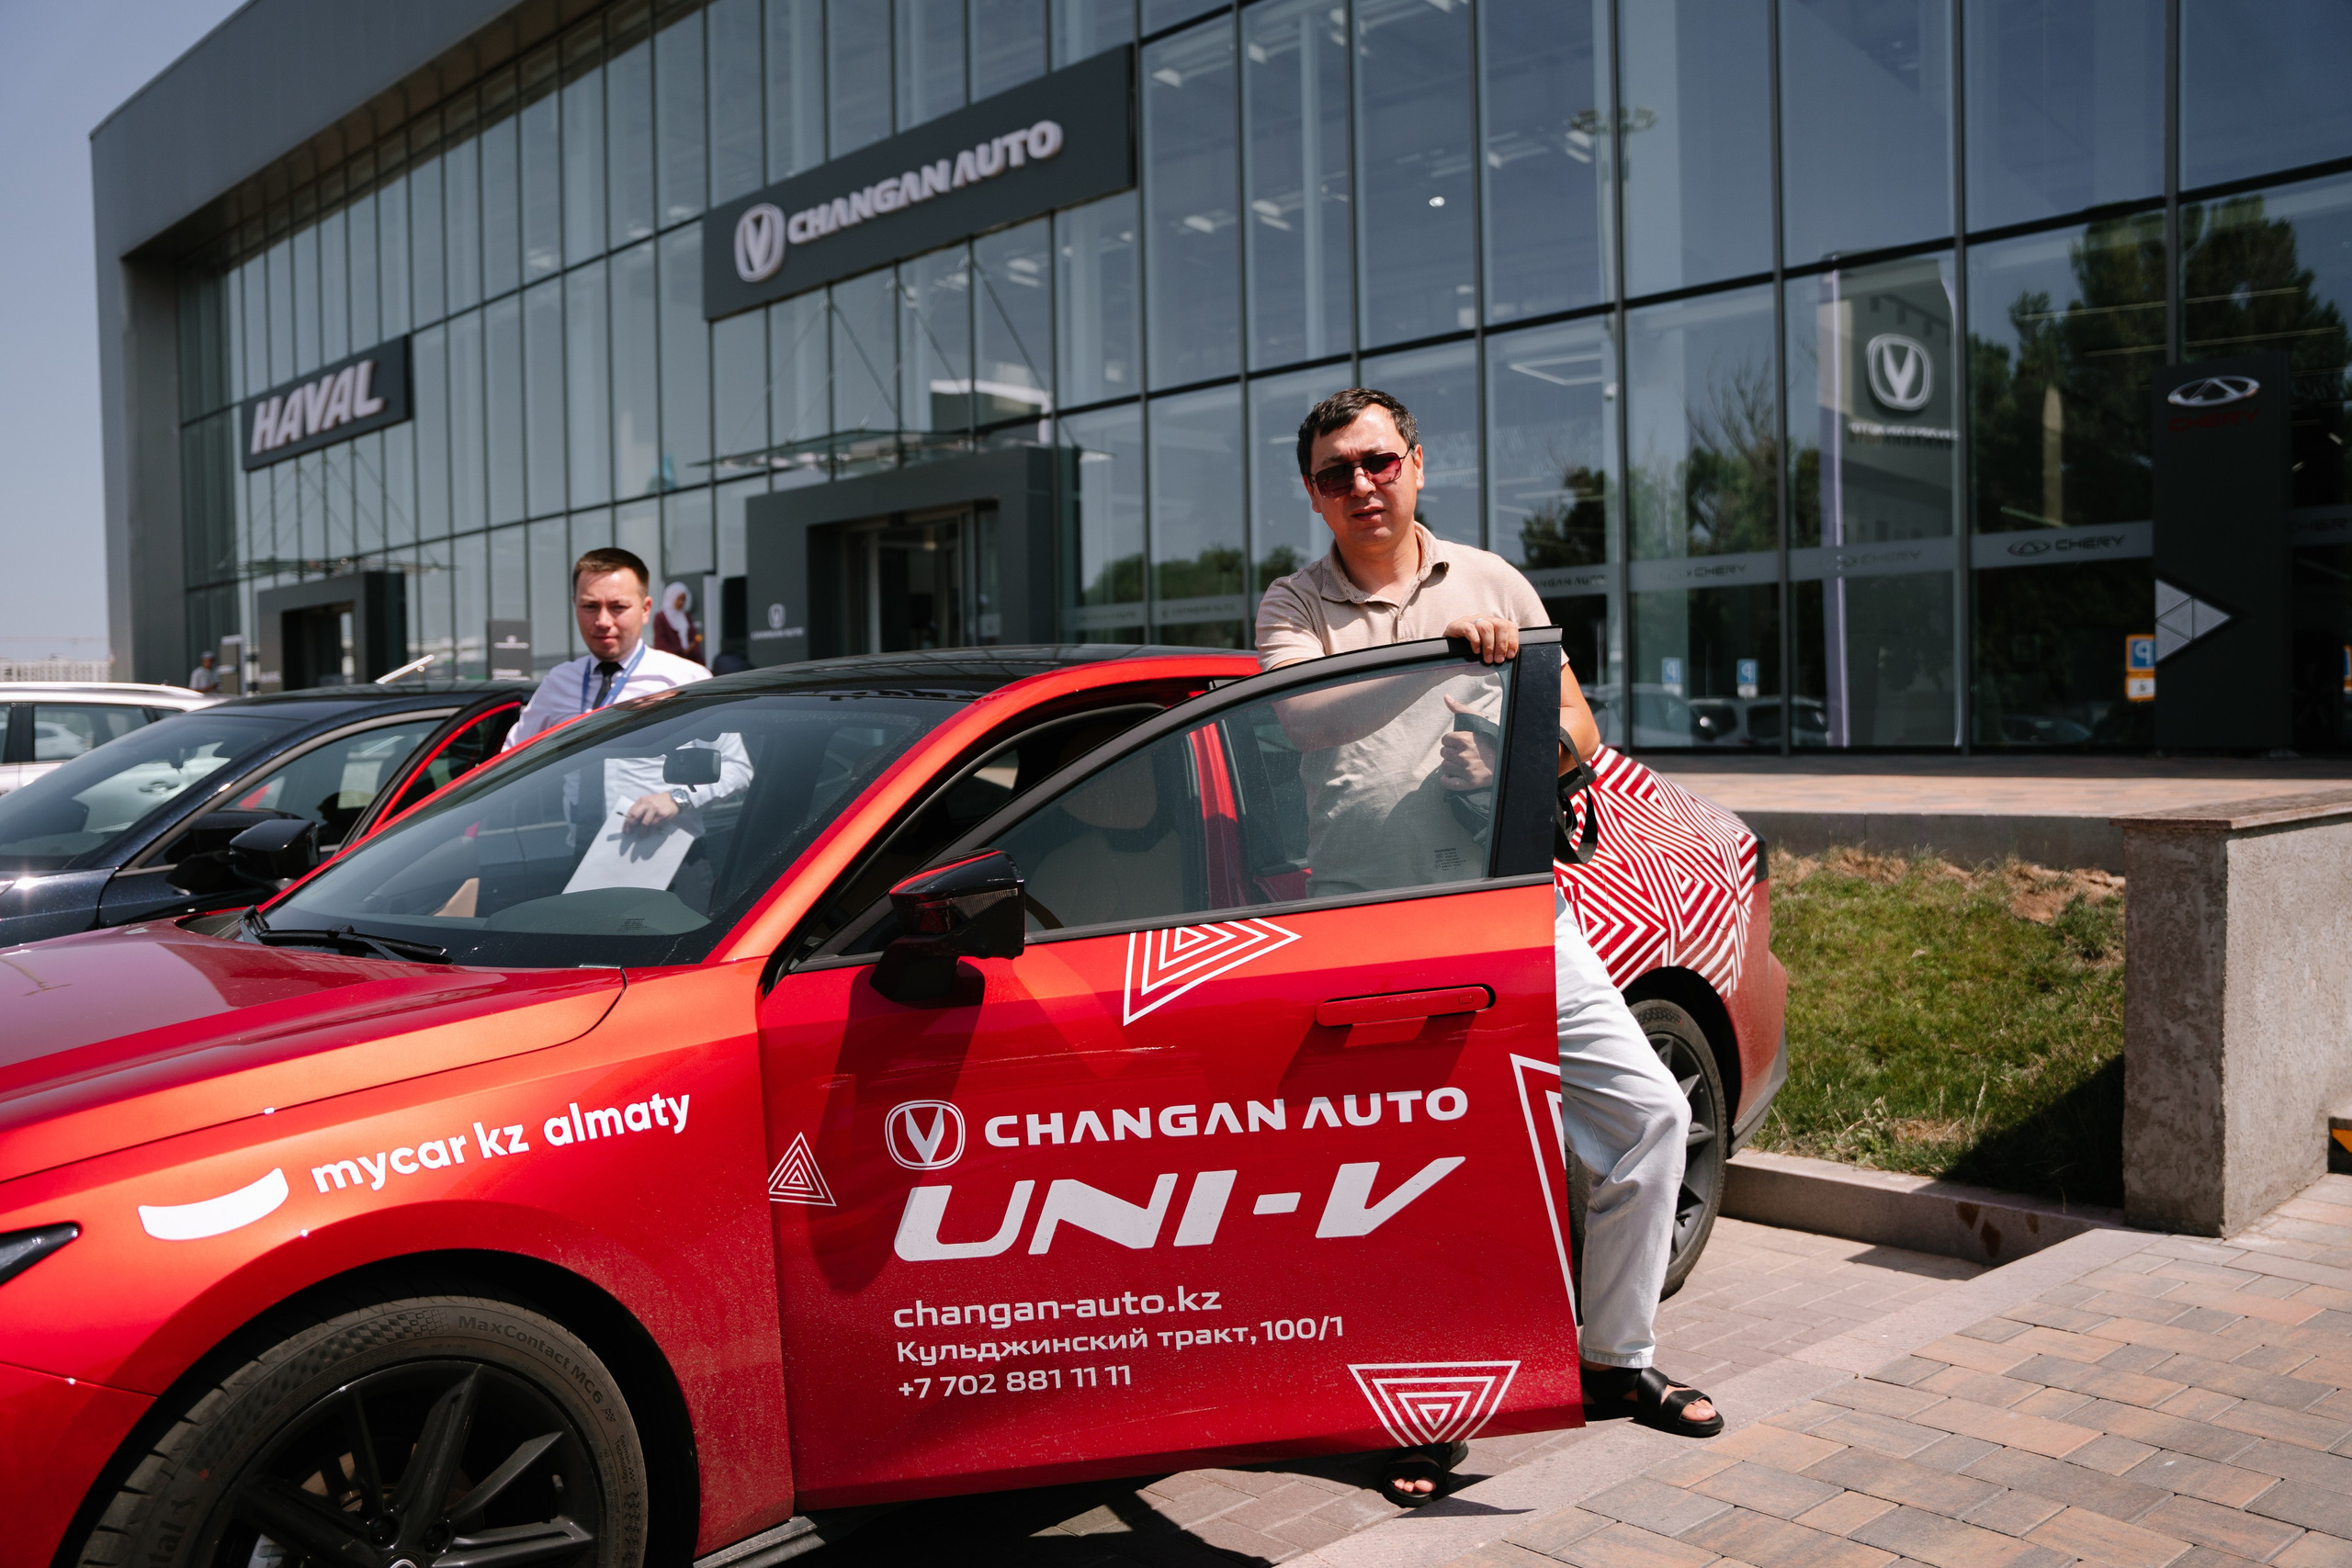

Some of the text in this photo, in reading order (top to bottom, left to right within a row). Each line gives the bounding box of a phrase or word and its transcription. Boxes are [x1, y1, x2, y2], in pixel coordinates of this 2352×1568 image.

[786, 120, 1063, 244] CHANGAN AUTO
[250, 359, 385, 455] HAVAL
[2168, 408, 2260, 433] CHERY
[2054, 534, 2125, 551] CHERY
[1532, 577, 1572, 589] ANGAN
[1694, 563, 1747, 579] CHERY
[985, 1087, 1468, 1147] CHANGAN AUTO
[311, 1092, 690, 1193] mycar kz almaty
[893, 1156, 1466, 1262] UNI-V
[893, 1285, 1222, 1329] changan-auto.kz
[459, 1315, 571, 1370] MaxContact
[571, 1363, 604, 1404] MC6
[897, 1327, 1148, 1367] Кульджинский
[1260, 1315, 1343, 1341] 100/1
[898, 1365, 1131, 1399] +7 702 881 11 11
[614, 1440, 629, 1483] Technology
[619, 1435, 631, 1465] German
[148, 1520, 187, 1568] tal
